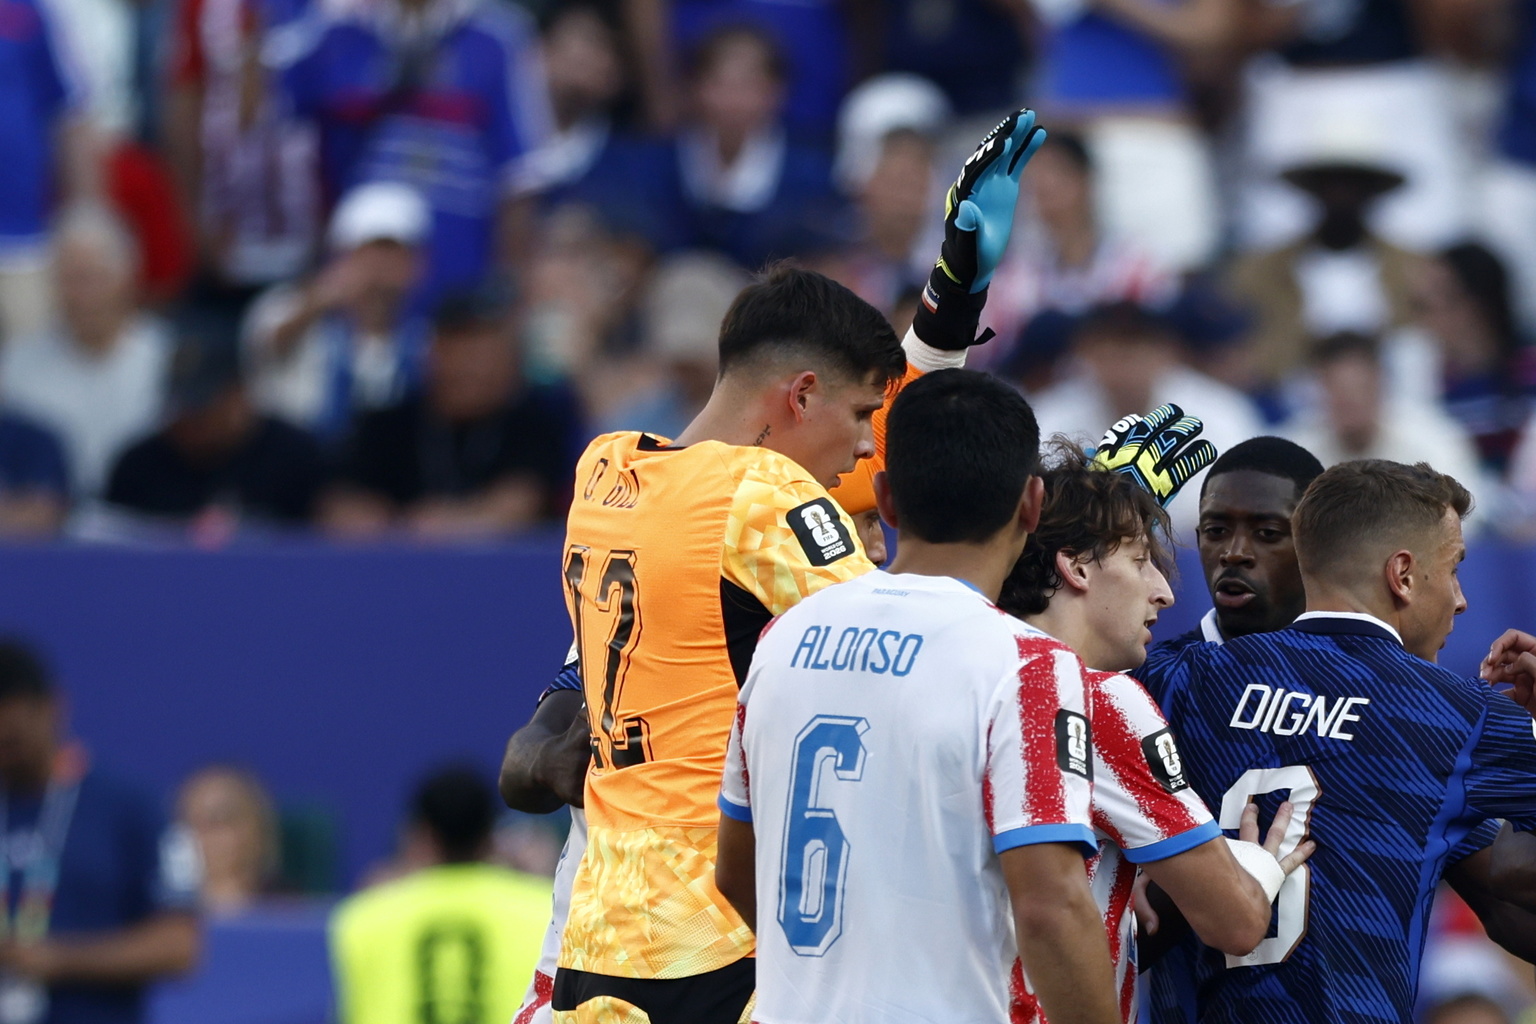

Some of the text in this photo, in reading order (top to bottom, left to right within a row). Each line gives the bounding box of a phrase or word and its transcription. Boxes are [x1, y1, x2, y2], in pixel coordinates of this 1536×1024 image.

[823, 545, 847, 561] 2026
[564, 544, 654, 776] 12
[789, 625, 924, 677] ALONSO
[1229, 683, 1370, 741] DIGNE
[777, 713, 871, 958] 6
